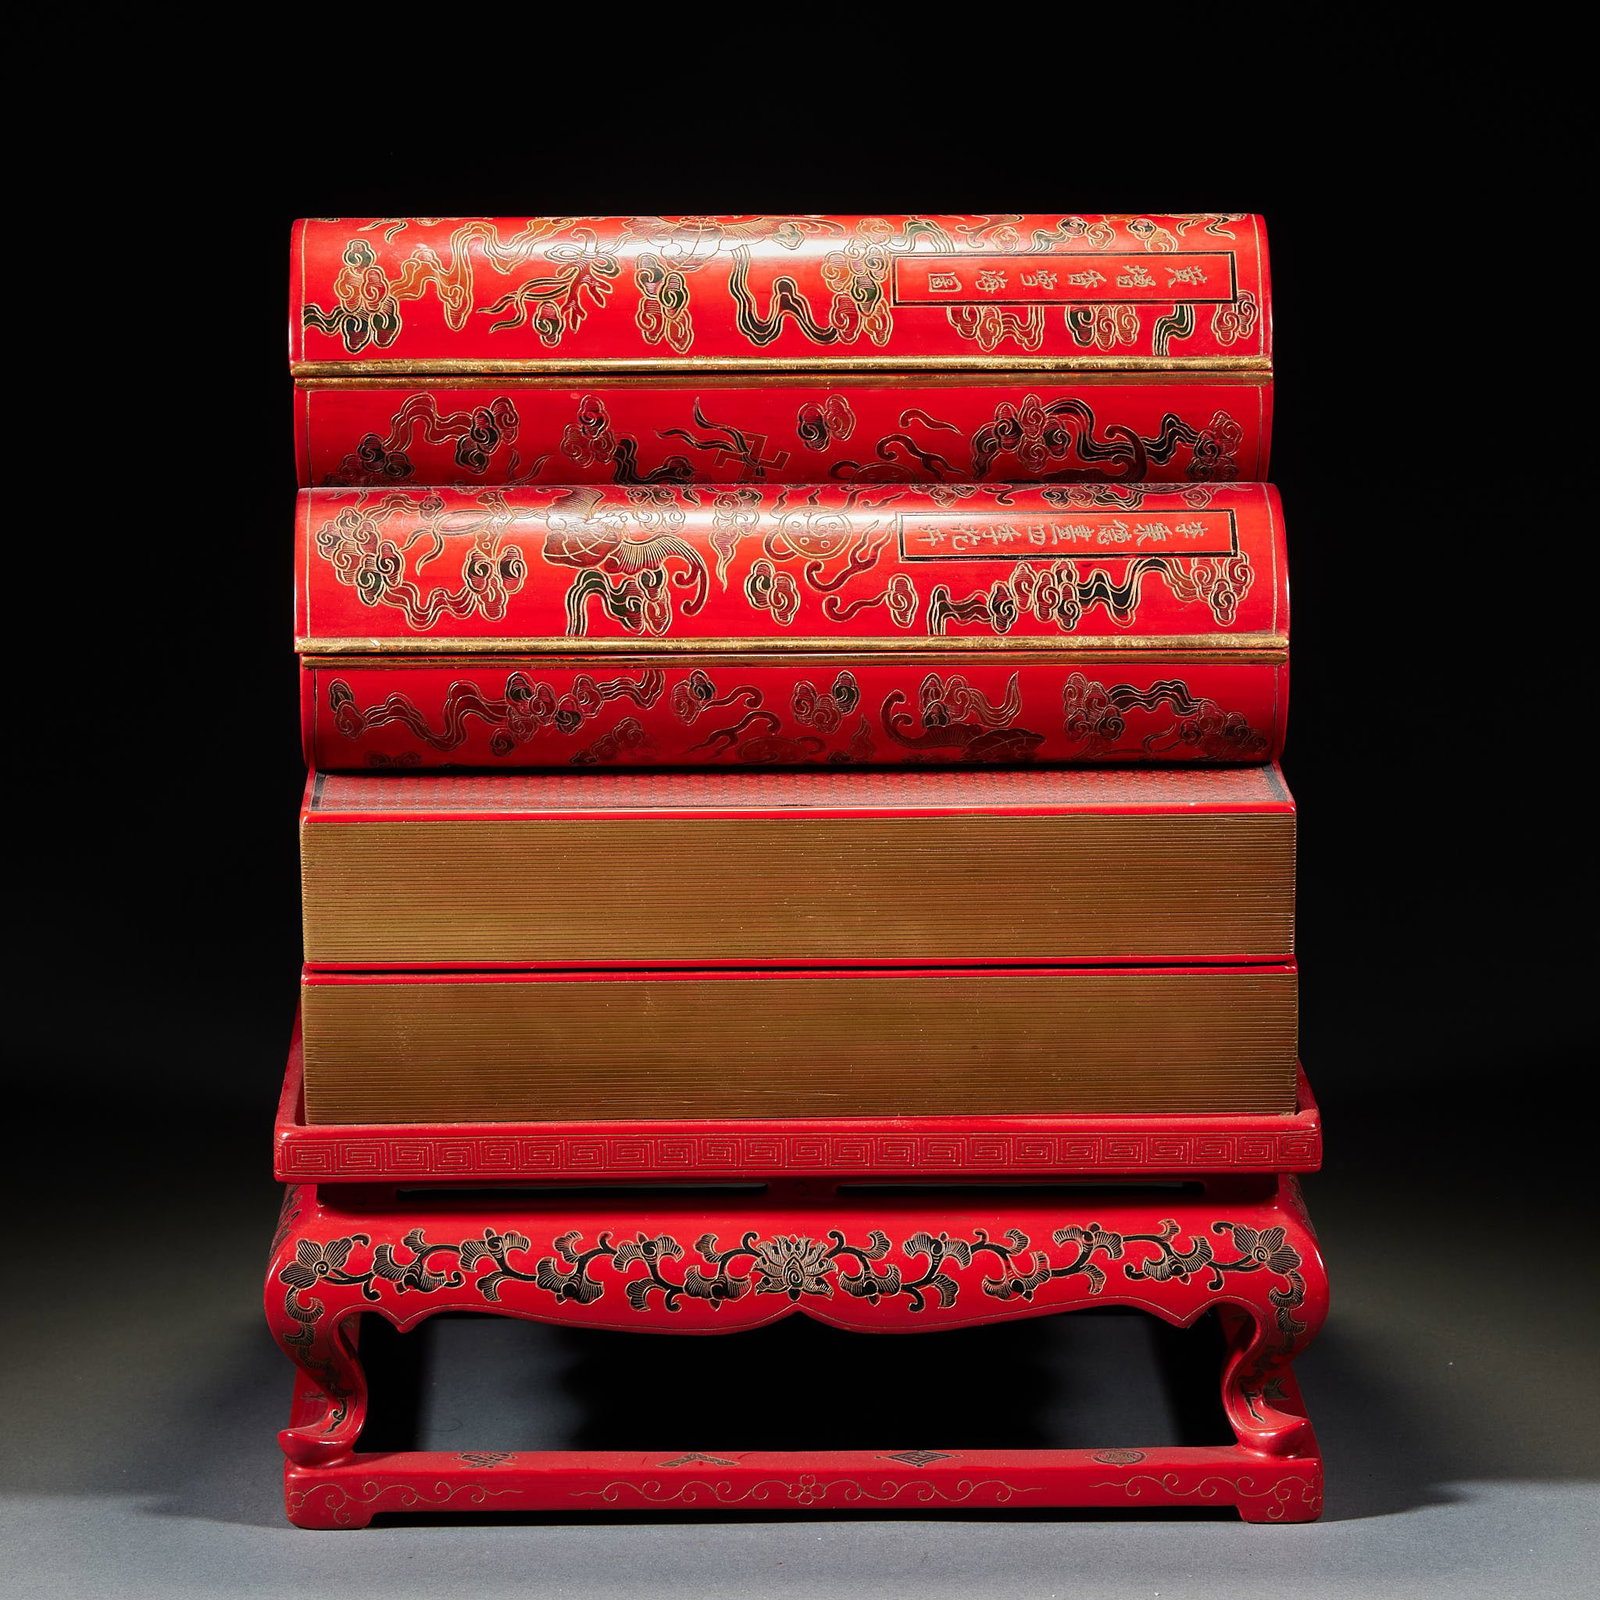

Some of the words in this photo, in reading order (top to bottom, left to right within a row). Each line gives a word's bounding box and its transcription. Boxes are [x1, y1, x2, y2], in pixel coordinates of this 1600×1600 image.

[917, 520, 1208, 551] 李秉德畫四季花卉
